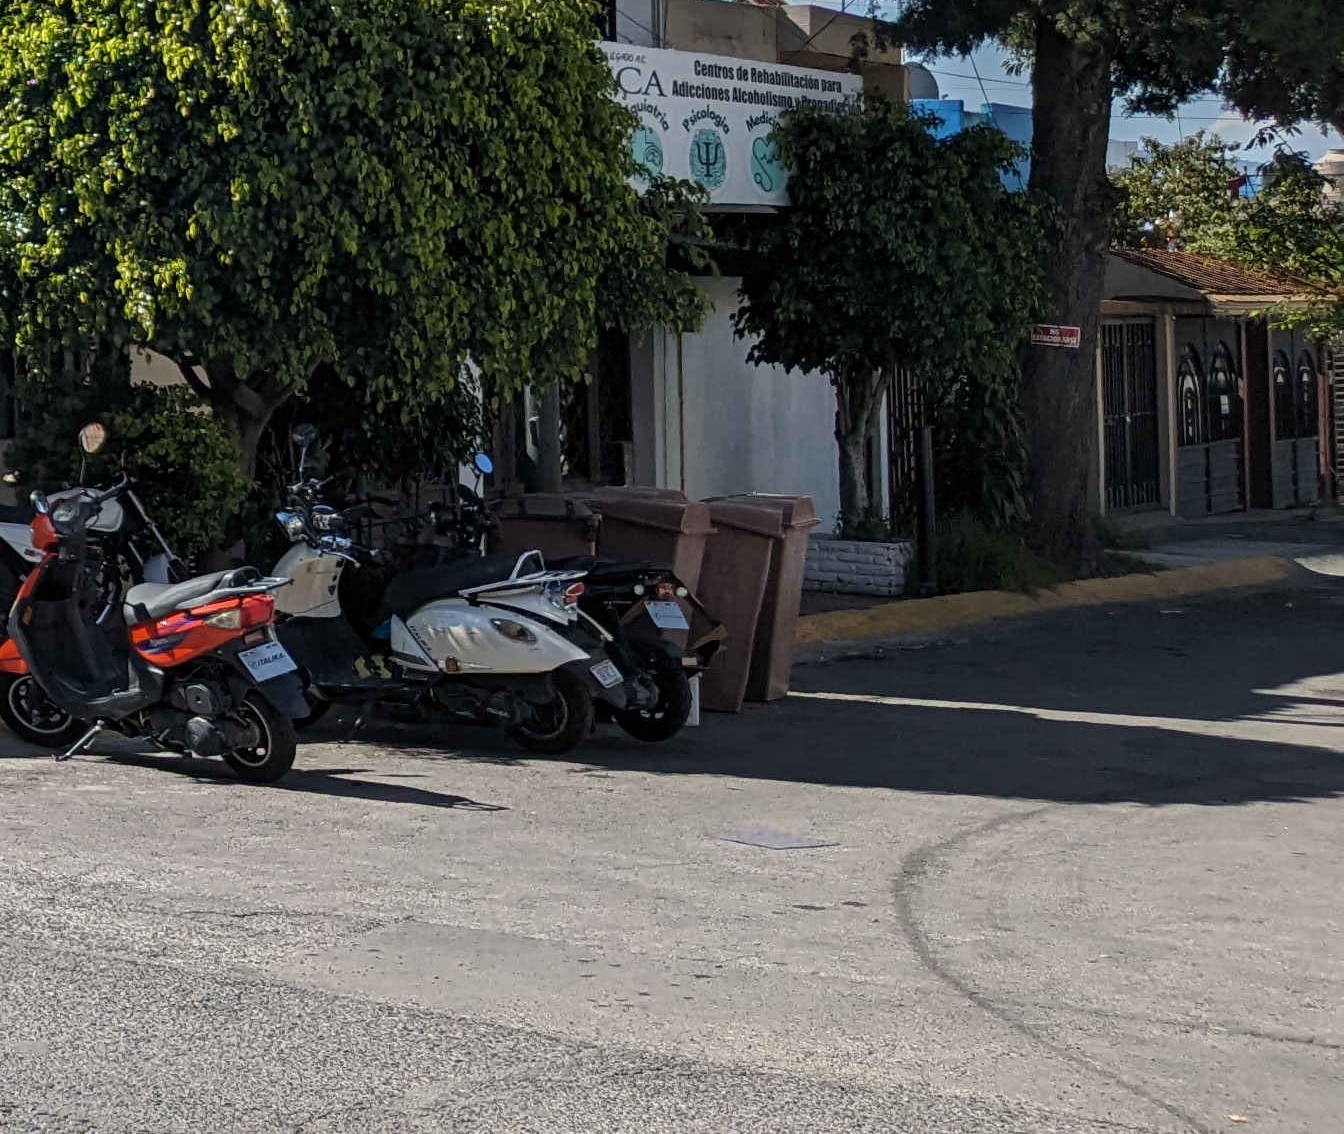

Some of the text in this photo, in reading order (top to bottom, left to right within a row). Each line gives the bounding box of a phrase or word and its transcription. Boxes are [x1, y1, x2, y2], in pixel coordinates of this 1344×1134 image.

[693, 59, 842, 94] Centros de Rehabilitación para
[671, 79, 730, 102] Adicciones
[732, 86, 793, 109] Alcoholismo
[745, 110, 782, 133] Medicin
[257, 652, 284, 667] ITALIKA
